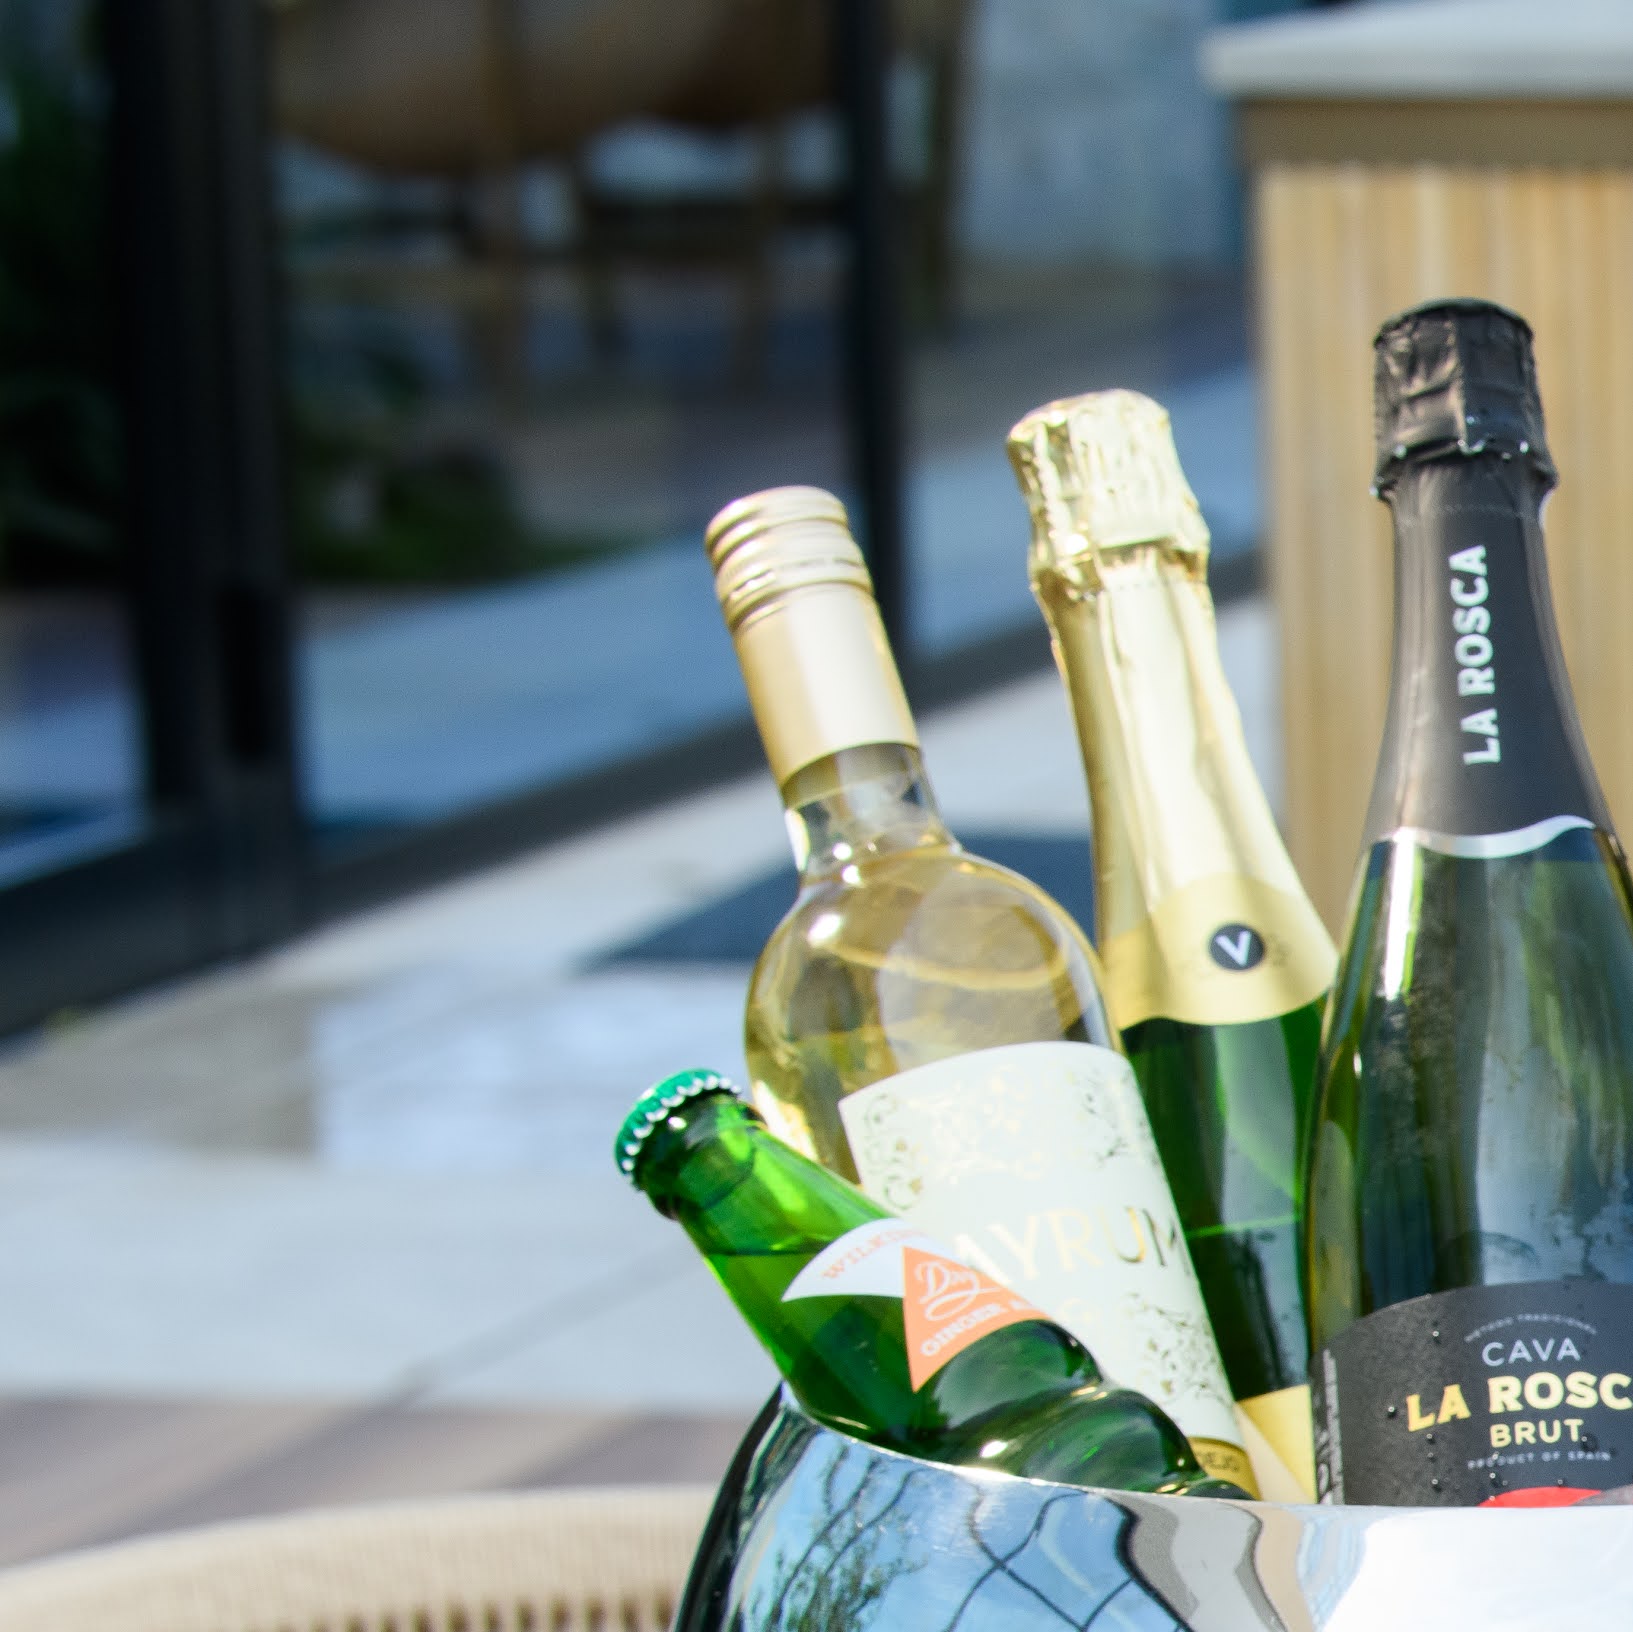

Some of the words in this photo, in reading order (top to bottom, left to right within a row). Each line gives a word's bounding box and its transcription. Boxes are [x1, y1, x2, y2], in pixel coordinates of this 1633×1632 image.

[1449, 544, 1497, 695] ROSCA
[1464, 711, 1501, 766] LA
[1214, 930, 1252, 967] V
[914, 1260, 1002, 1322] Dry
[919, 1302, 1010, 1357] GINGER
[1481, 1336, 1582, 1367] CAVA
[1405, 1384, 1471, 1432] LA
[1489, 1418, 1584, 1449] BRUT
[1541, 1450, 1561, 1462] OF
[1567, 1450, 1612, 1462] SPAIN
